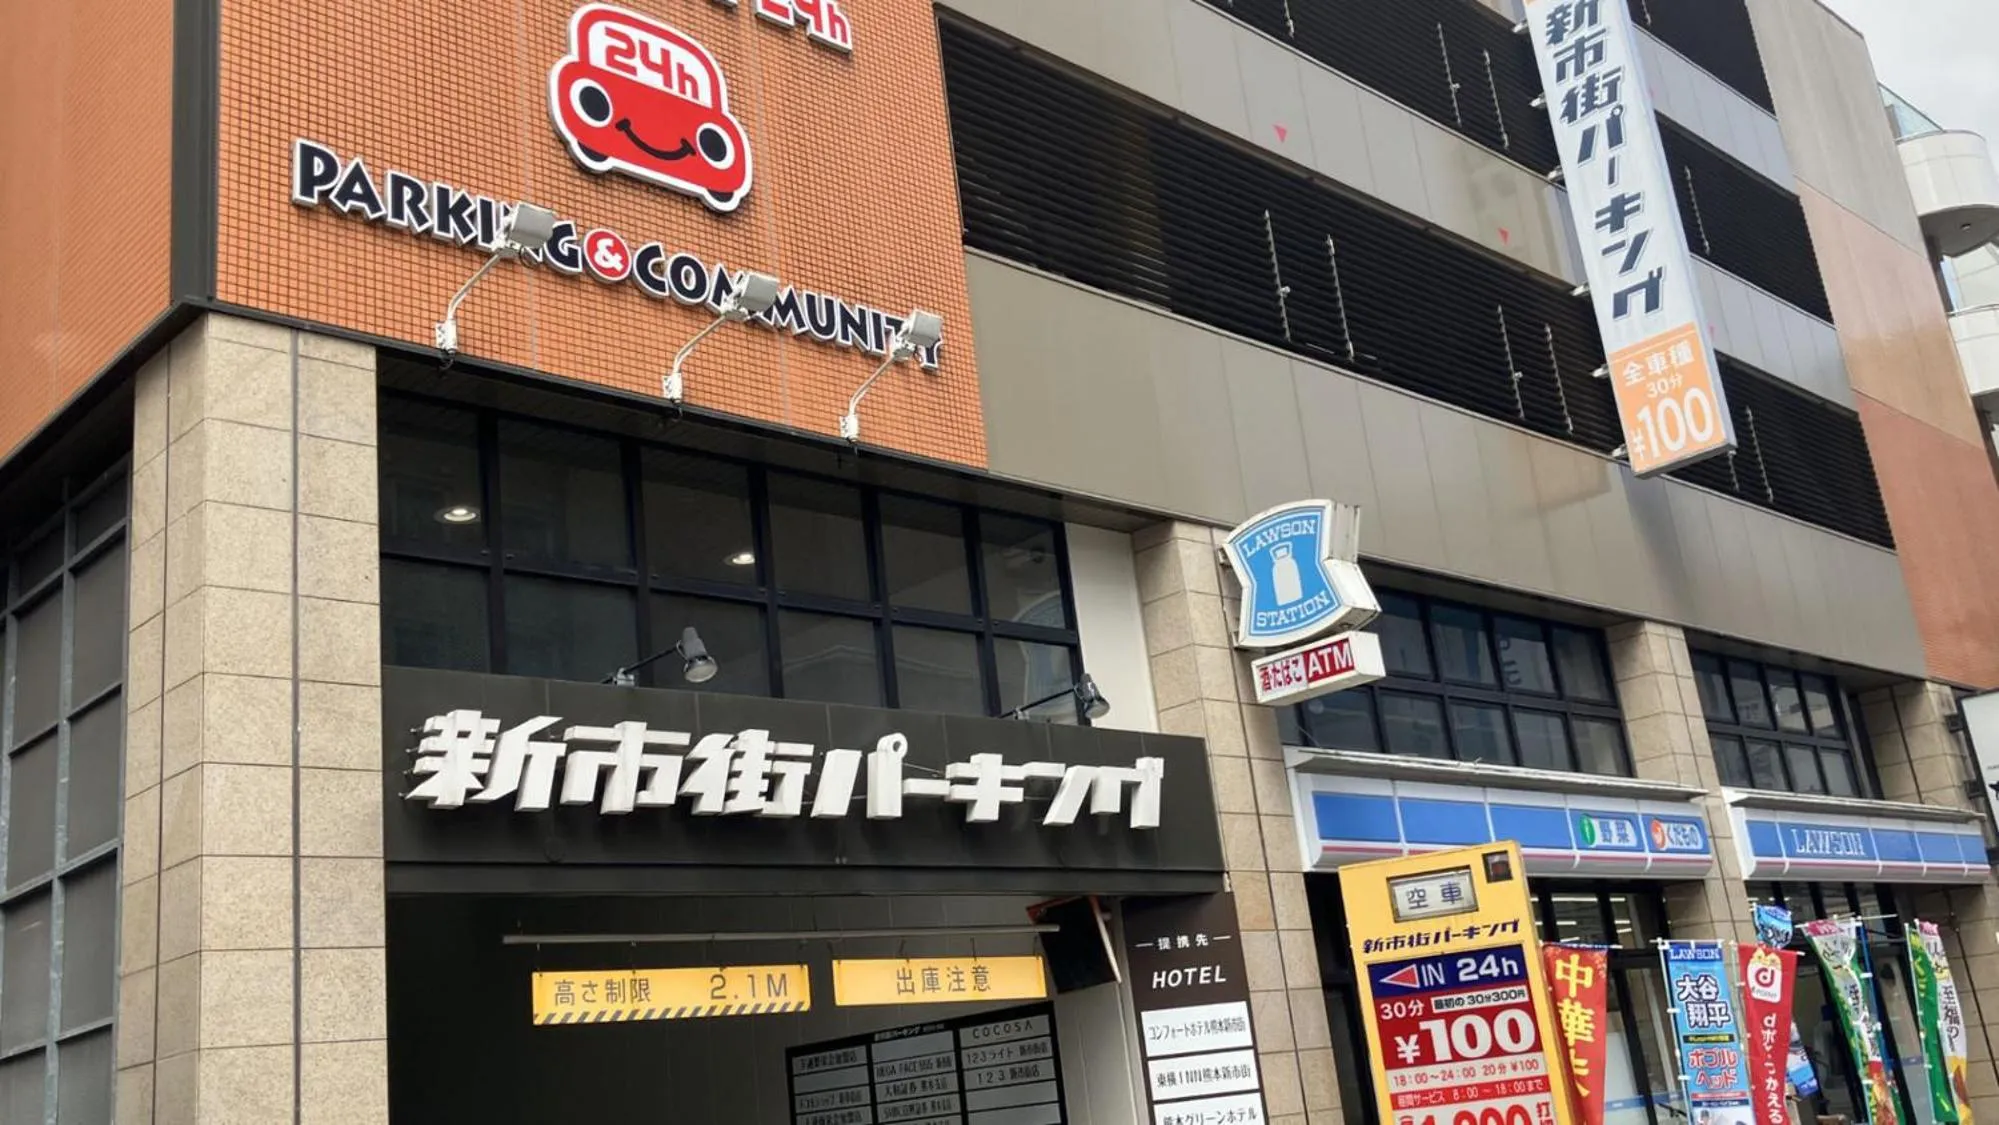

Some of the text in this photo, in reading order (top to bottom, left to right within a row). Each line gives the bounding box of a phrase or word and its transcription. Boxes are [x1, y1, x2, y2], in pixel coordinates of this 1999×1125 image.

[605, 26, 699, 100] 24h
[1545, 0, 1665, 319] 新市街パーキング
[293, 138, 582, 275] PARKIG
[1622, 340, 1695, 387] 全車種
[1646, 373, 1683, 398] 30分
[1630, 387, 1714, 461] ¥100
[1243, 519, 1316, 558] LAWSON
[1256, 590, 1331, 626] STATION
[1308, 642, 1353, 679] ATM
[403, 708, 1165, 829] 新市街パーキング
[1600, 820, 1631, 844] 野菜
[1790, 828, 1866, 857] LAWSON
[1406, 881, 1465, 910] 空車
[1157, 934, 1209, 950] 提携先
[1363, 918, 1520, 954] 新市街パーキング
[1421, 954, 1519, 987] IN 24h
[1669, 948, 1720, 960] LAWSON
[554, 974, 789, 1007] 高さ制限 2.1M
[895, 965, 992, 996] 出庫注意
[1152, 965, 1227, 989] HOTEL
[1676, 974, 1719, 1001] 大谷
[1380, 1001, 1425, 1020] 30分
[1686, 1001, 1731, 1028] 翔平
[972, 1020, 1033, 1039] COCOSA
[1394, 1008, 1536, 1065] ¥100
